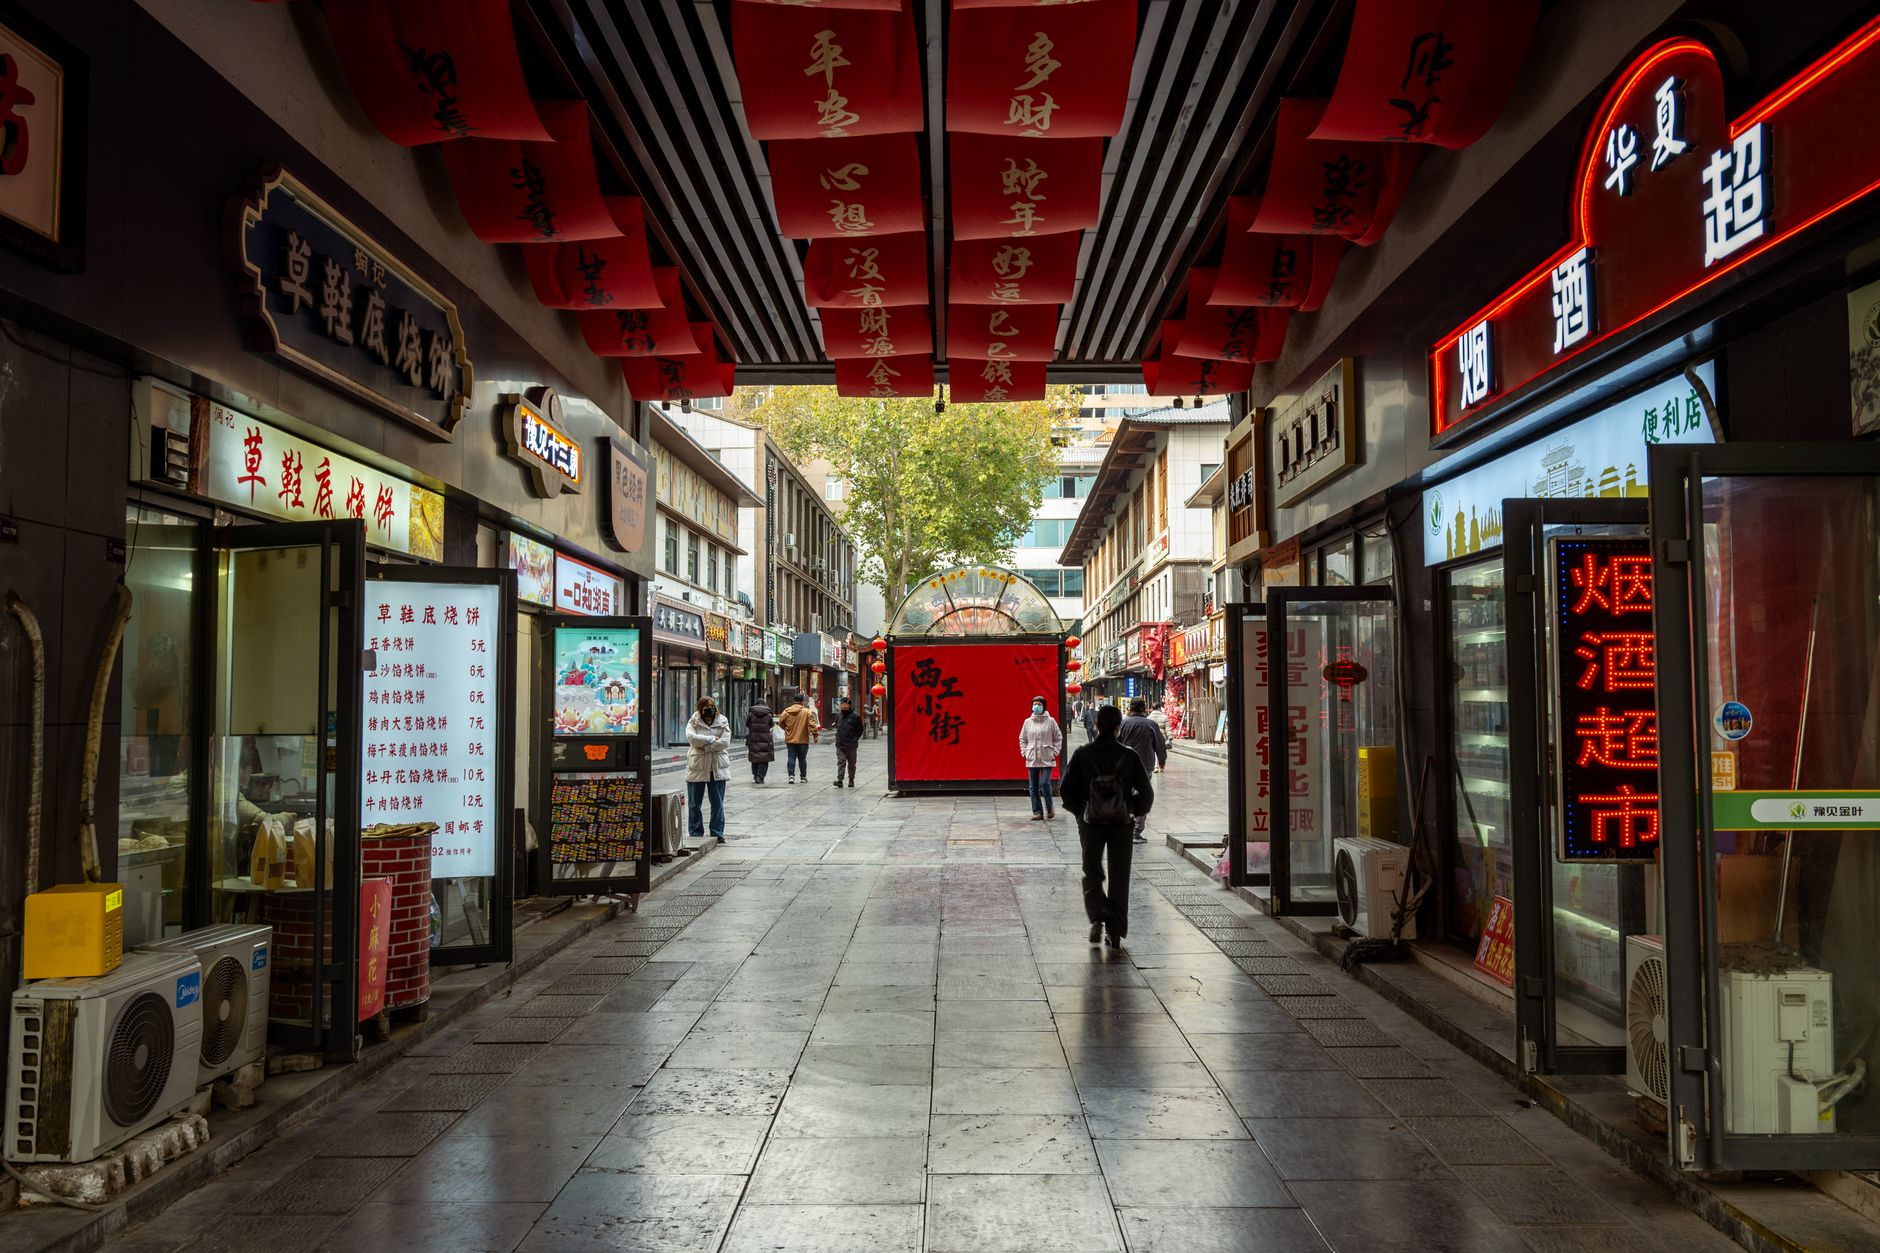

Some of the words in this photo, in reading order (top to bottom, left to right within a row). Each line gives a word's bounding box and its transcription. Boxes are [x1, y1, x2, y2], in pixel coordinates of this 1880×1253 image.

[804, 29, 859, 138] 平安
[1003, 31, 1061, 138] 多财
[1605, 76, 1687, 197] 华夏
[820, 163, 874, 237] 心想
[1000, 157, 1049, 237] 蛇年
[988, 246, 1033, 302] 好运
[281, 230, 452, 401] 草鞋底烧饼
[859, 309, 896, 355] 财源
[214, 407, 235, 429] 润记
[1642, 389, 1701, 446] 便利店
[237, 426, 395, 543] 草鞋底烧饼
[377, 603, 480, 626] 草鞋底烧饼
[369, 637, 415, 651] 五香烧饼
[471, 640, 486, 652] 5元
[470, 665, 485, 678] 6元
[368, 689, 426, 705] 鸡肉馅烧饼
[469, 691, 485, 704] 6元
[911, 658, 966, 746] 西工小街
[1570, 554, 1658, 847] 烟酒超市
[367, 716, 448, 731] 猪肉大葱馅烧饼
[469, 717, 484, 730] 7元
[367, 742, 448, 758] 梅干菜瘦肉馅烧饼
[468, 742, 484, 756] 9元
[366, 769, 449, 784] 牡丹花馅烧饼
[463, 768, 485, 782] 10元
[365, 795, 423, 811] 牛肉馅烧饼
[463, 795, 484, 808] 12元
[1253, 808, 1314, 832] 立可取
[1813, 806, 1863, 817] 豫见金叶
[431, 820, 484, 835] 国邮寄
[367, 894, 381, 982] 小麻花
[178, 983, 200, 1001] Midea
